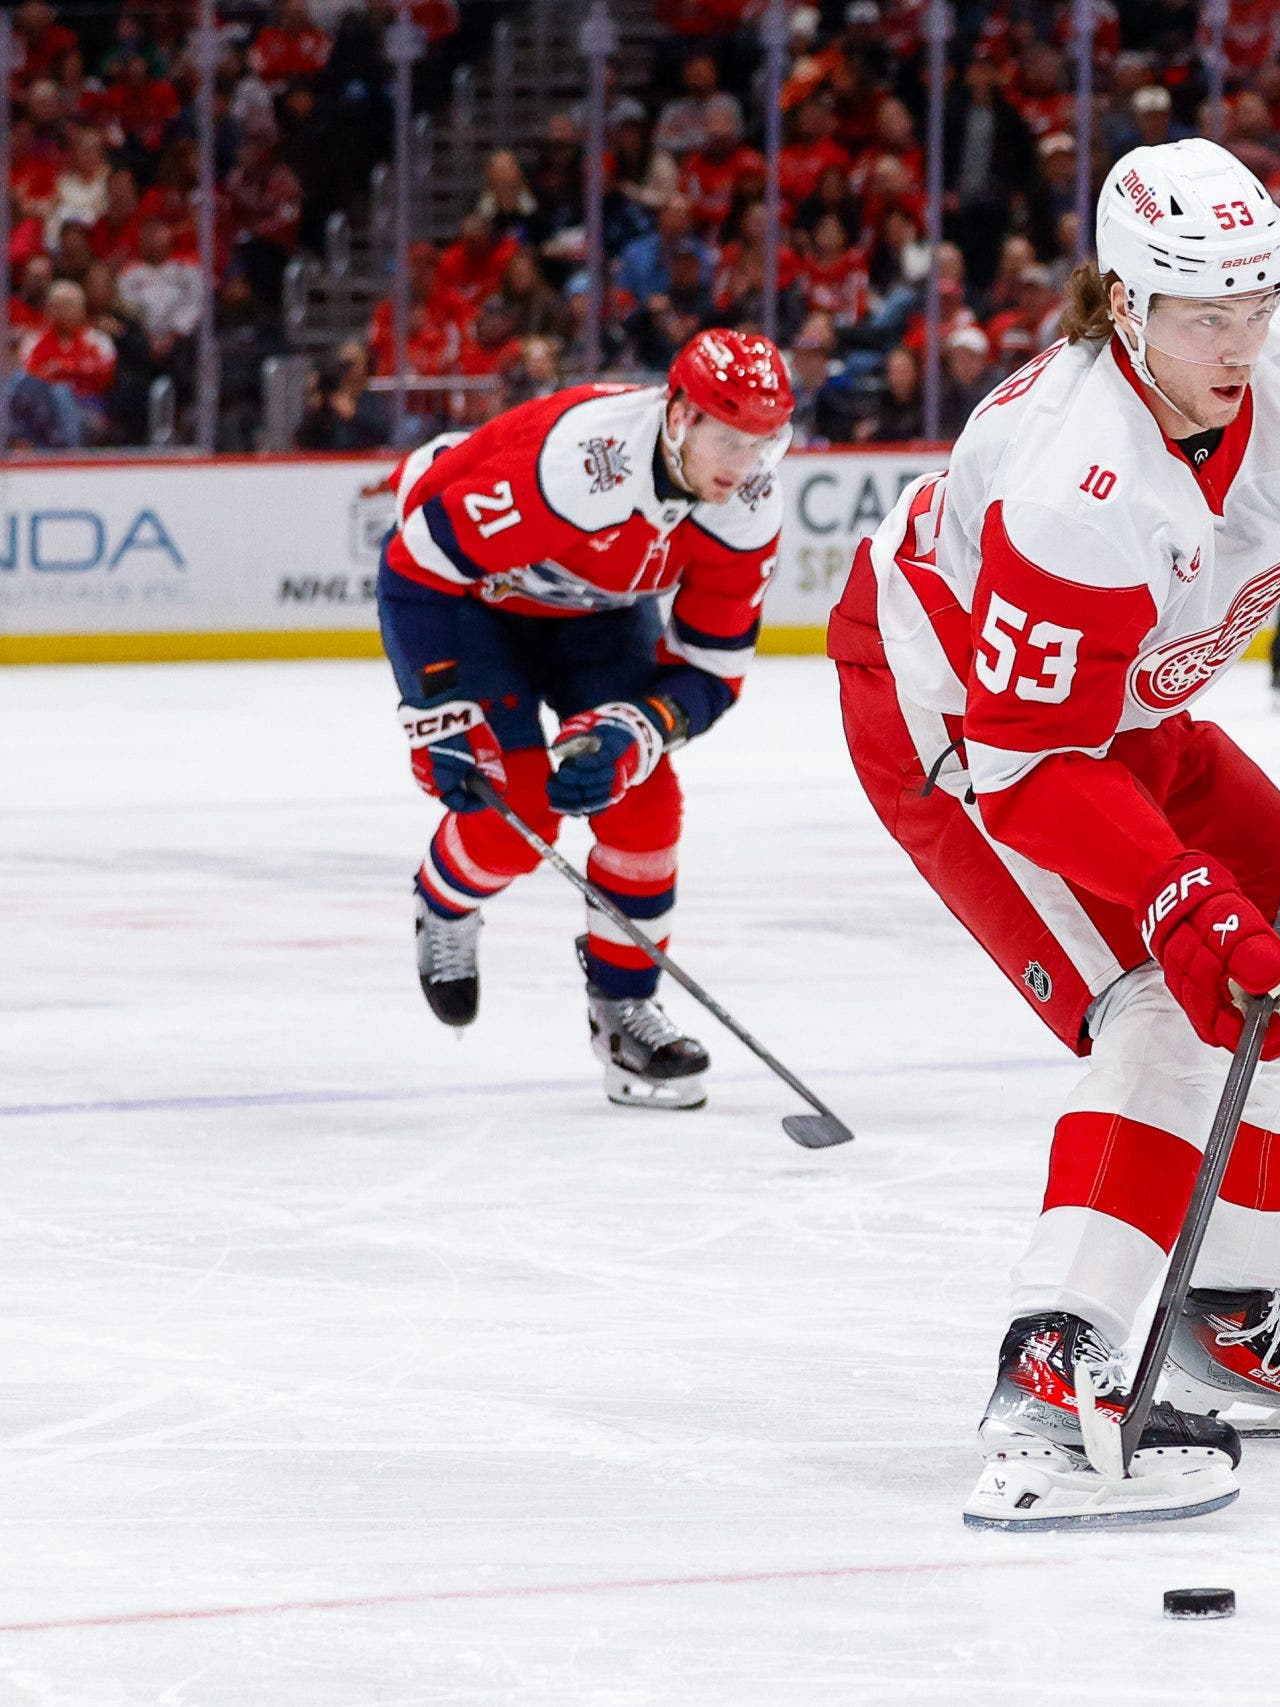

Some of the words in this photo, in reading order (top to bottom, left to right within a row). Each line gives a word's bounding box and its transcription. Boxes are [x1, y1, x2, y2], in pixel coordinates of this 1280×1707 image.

[1121, 168, 1165, 226] meijer
[1211, 200, 1254, 231] 53
[1220, 252, 1272, 270] BAUER
[1080, 464, 1118, 501] 10
[463, 480, 522, 539] 21
[976, 590, 1084, 704] 53
